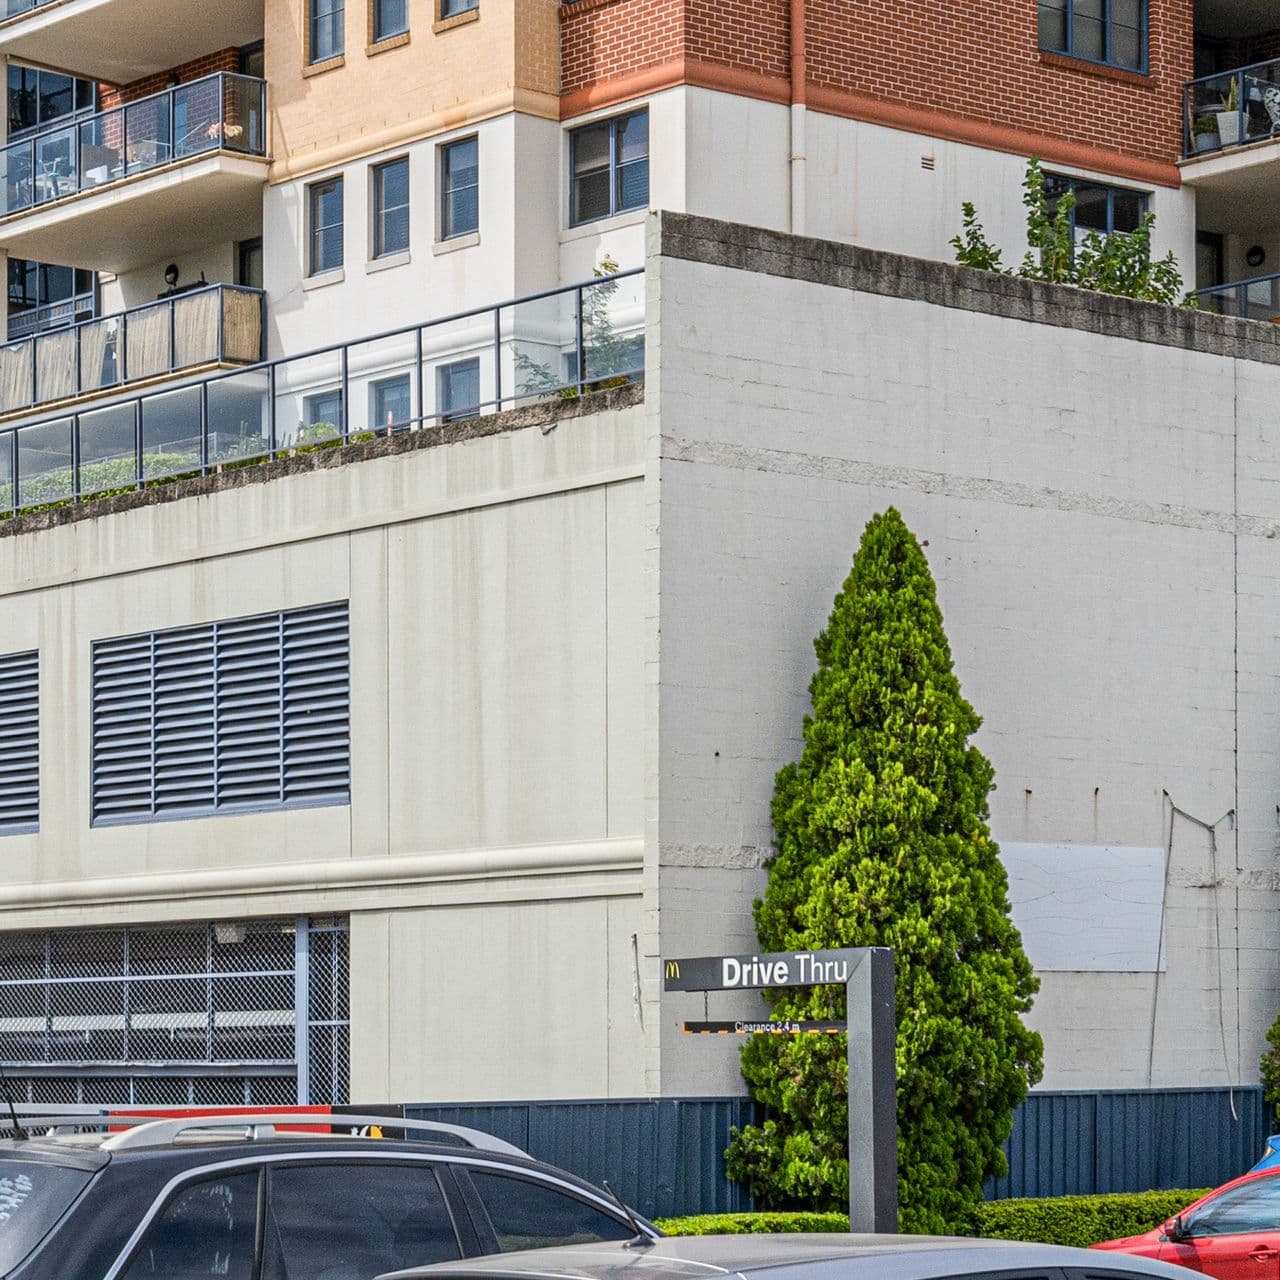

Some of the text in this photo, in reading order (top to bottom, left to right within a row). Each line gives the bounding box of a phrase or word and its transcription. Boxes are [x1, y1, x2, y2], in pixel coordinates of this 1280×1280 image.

[722, 954, 847, 987] Drive Thru
[735, 1021, 800, 1032] Clearance 2.4 m
